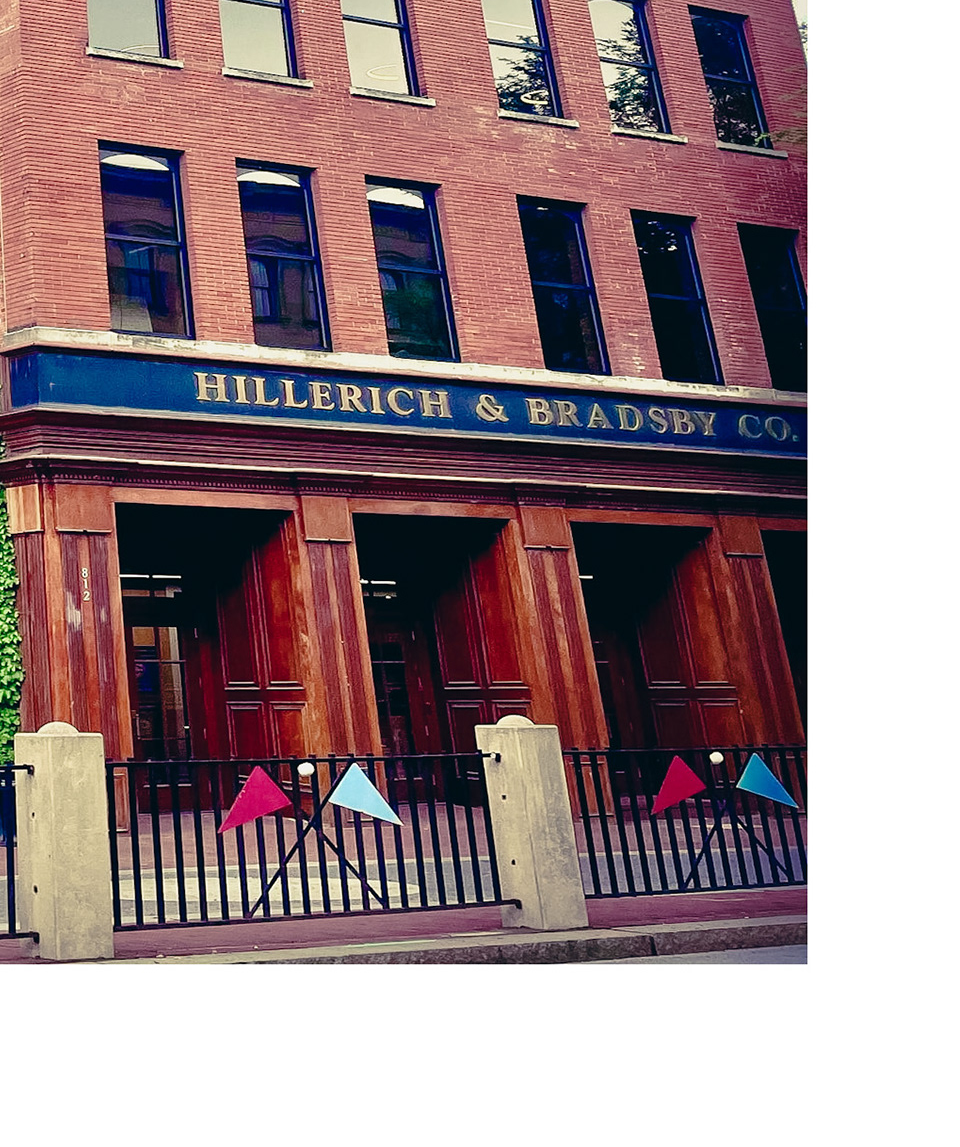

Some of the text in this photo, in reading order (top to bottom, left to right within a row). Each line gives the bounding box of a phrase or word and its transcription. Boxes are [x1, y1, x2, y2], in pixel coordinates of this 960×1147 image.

[192, 371, 800, 443] HILLERICH & BRADSBY CO.
[80, 567, 91, 602] 812
